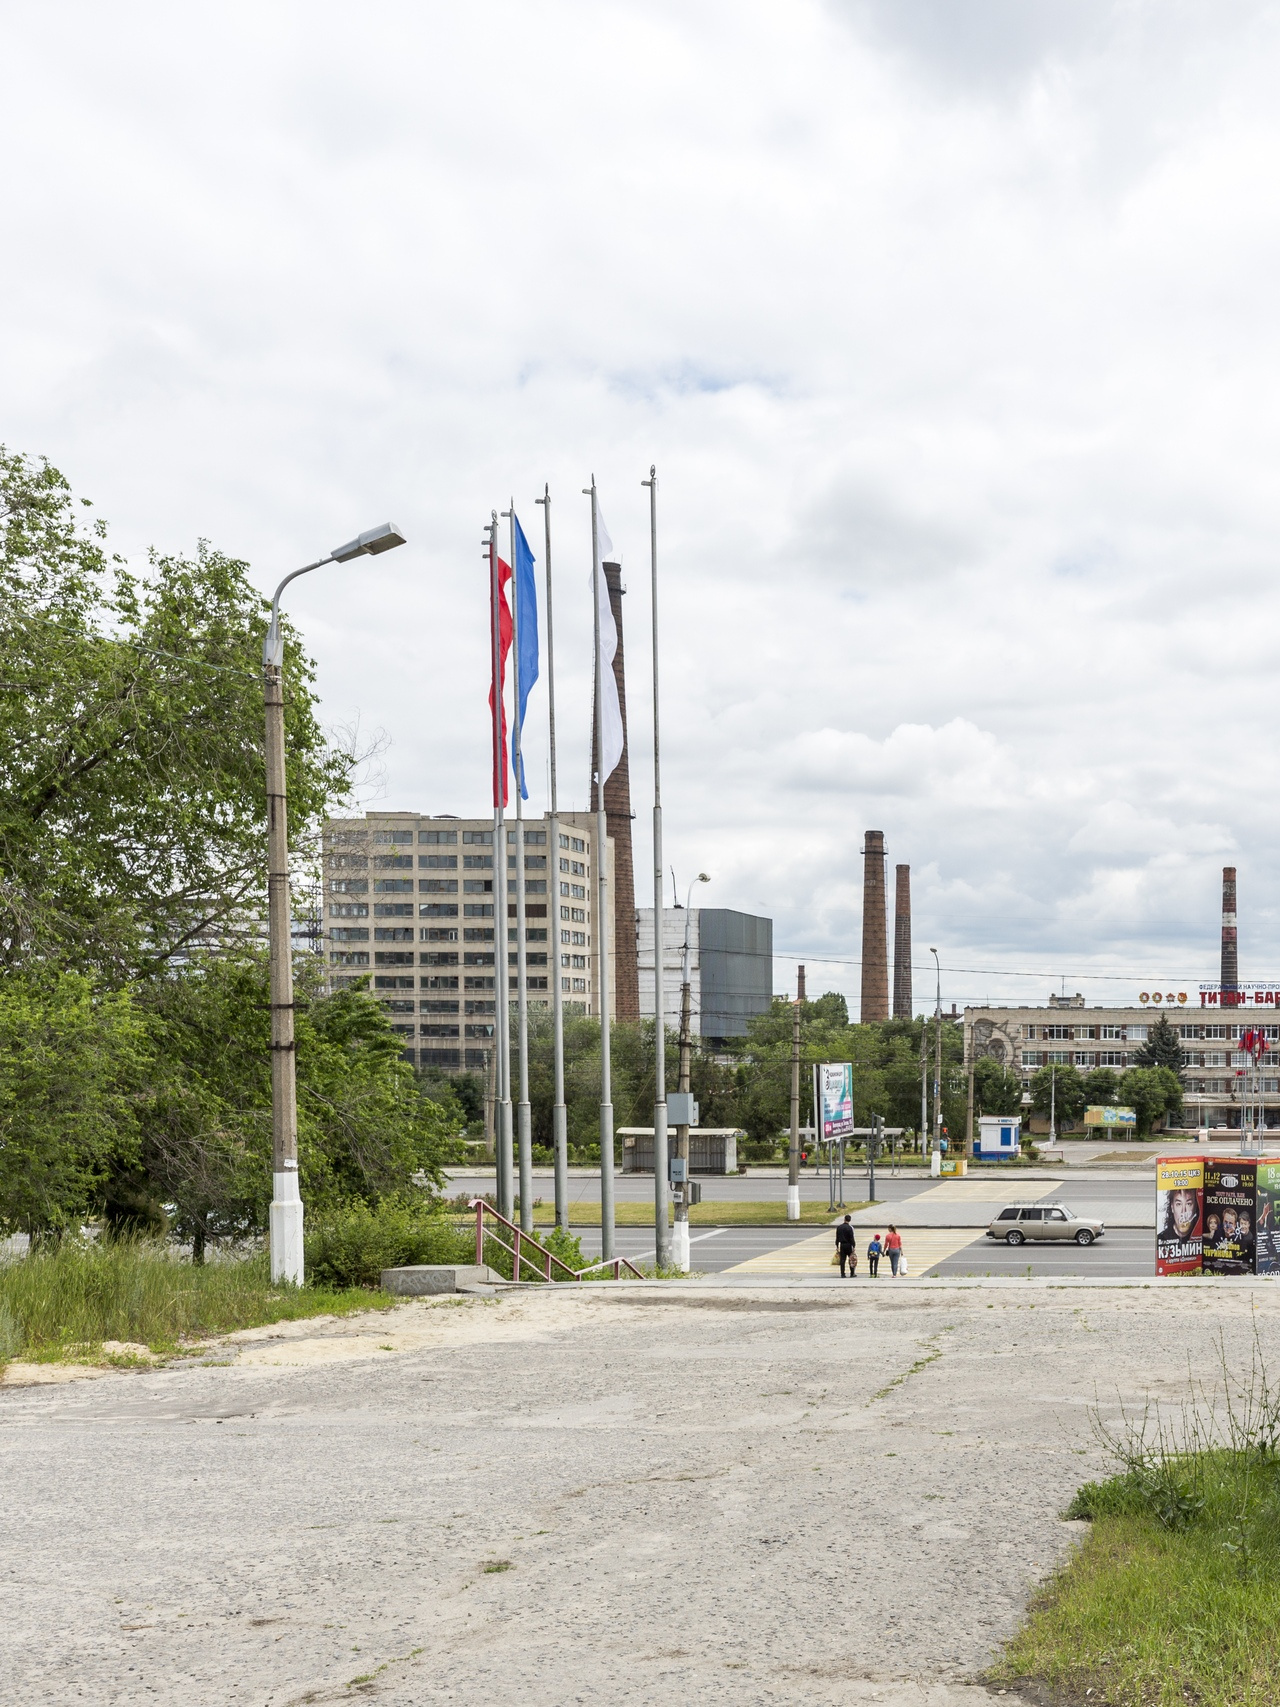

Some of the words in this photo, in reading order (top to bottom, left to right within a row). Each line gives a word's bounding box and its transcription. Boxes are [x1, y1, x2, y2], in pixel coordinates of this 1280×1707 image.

[1161, 1170, 1188, 1179] 28.10.15
[1188, 1169, 1201, 1178] ЦКЗ
[1205, 1172, 1220, 1180] 11.12
[1240, 1174, 1254, 1182] ЦКЗ
[1267, 1167, 1276, 1179] 18
[1174, 1179, 1189, 1187] 19:00
[1206, 1195, 1219, 1204] ВСЕ
[1219, 1196, 1254, 1207] ОПЛАЧЕНО
[1158, 1243, 1203, 1259] КУЗЬМИН
